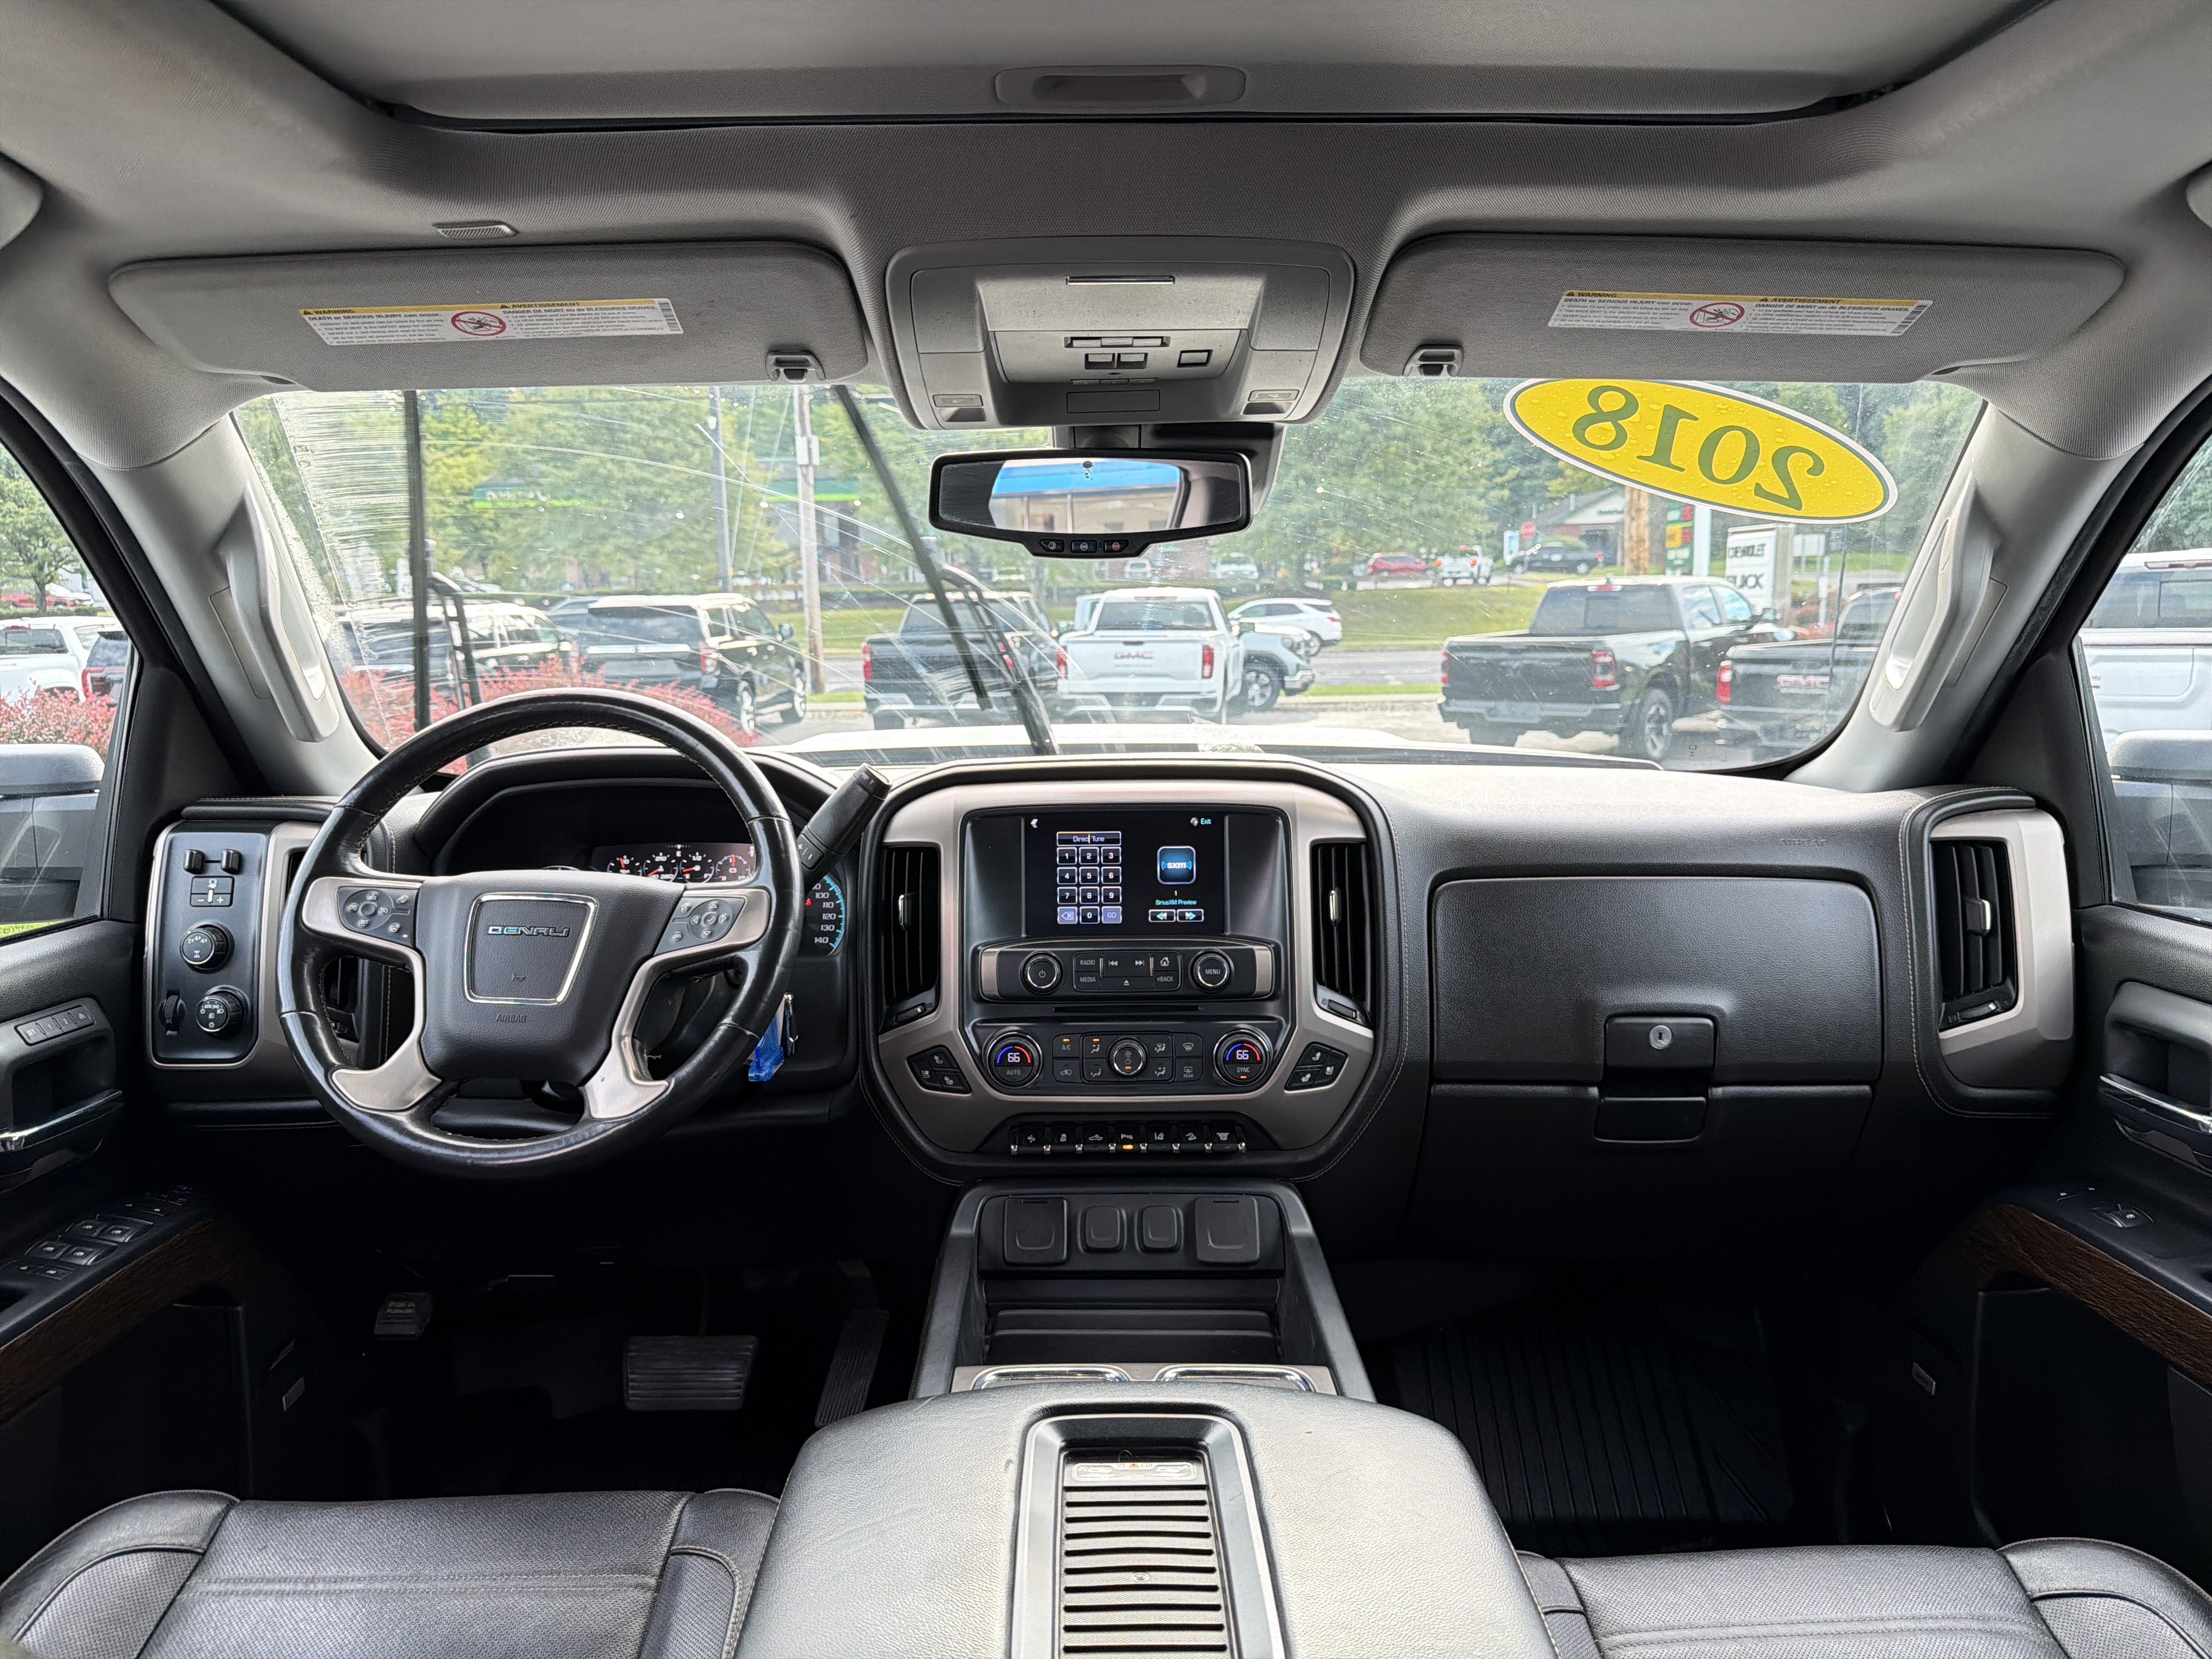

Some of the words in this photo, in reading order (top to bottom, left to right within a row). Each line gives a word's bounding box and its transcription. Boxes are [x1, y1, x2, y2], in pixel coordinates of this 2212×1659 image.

[1777, 675, 1831, 689] GMC
[488, 926, 571, 937] DENALI
[495, 1014, 527, 1023] AIRBAG
[1007, 1052, 1020, 1063] 66
[1236, 1049, 1249, 1060] 66
